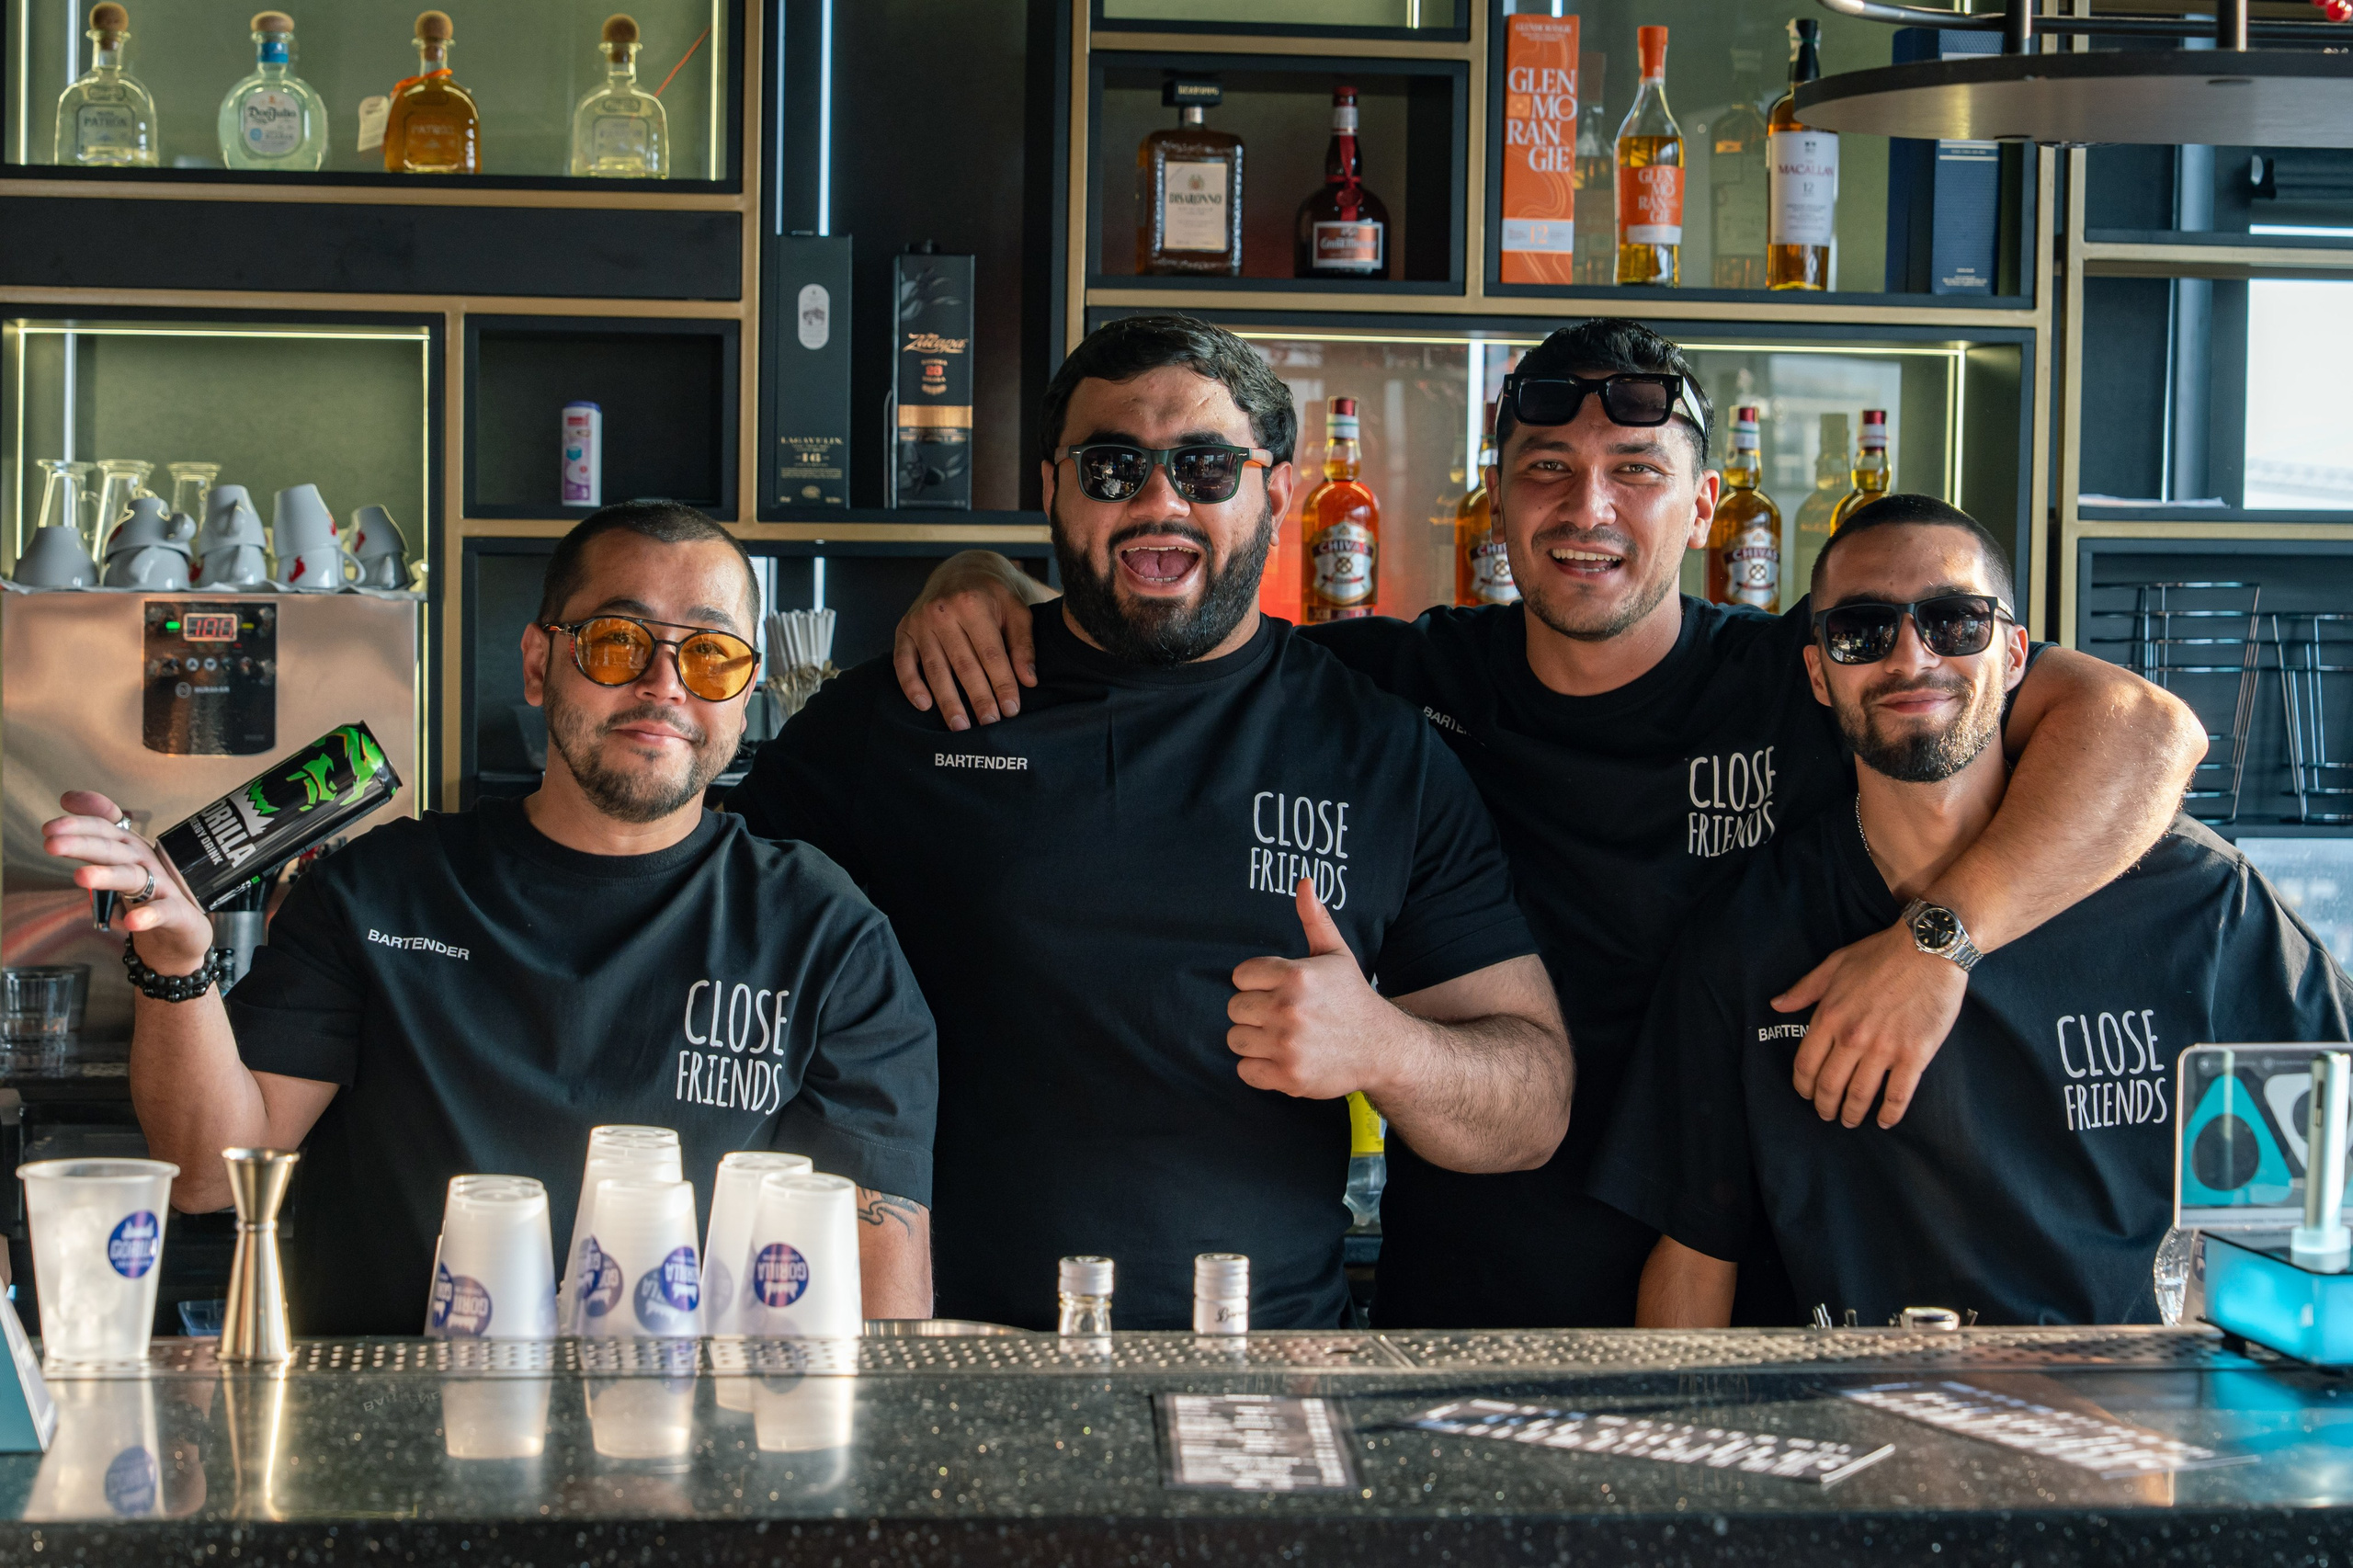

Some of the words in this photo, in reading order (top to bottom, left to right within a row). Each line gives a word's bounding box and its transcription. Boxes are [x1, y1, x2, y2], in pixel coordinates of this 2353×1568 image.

[1508, 66, 1575, 95] GLEN
[1532, 94, 1578, 121] MO
[1506, 119, 1561, 145] RAN
[1529, 146, 1571, 172] GIE
[1638, 167, 1677, 184] GLEN
[1529, 224, 1549, 244] 12
[1733, 547, 1779, 562] CHIVAS
[195, 617, 234, 638] 100
[934, 753, 1029, 770] BARTENDER
[1688, 745, 1777, 812] CLOSE
[201, 799, 256, 869] ORILLA
[1254, 791, 1349, 859] CLOSE
[200, 835, 223, 866] DRINK
[368, 928, 470, 960] BARTENDER
[684, 979, 790, 1056] CLOSE
[1757, 1024, 1810, 1041] BARTEN
[2056, 1008, 2165, 1079] CLOSE
[676, 1051, 783, 1116] FRIENDS
[2063, 1077, 2168, 1131] FRIENDS
[756, 1261, 808, 1281] GORILLA
